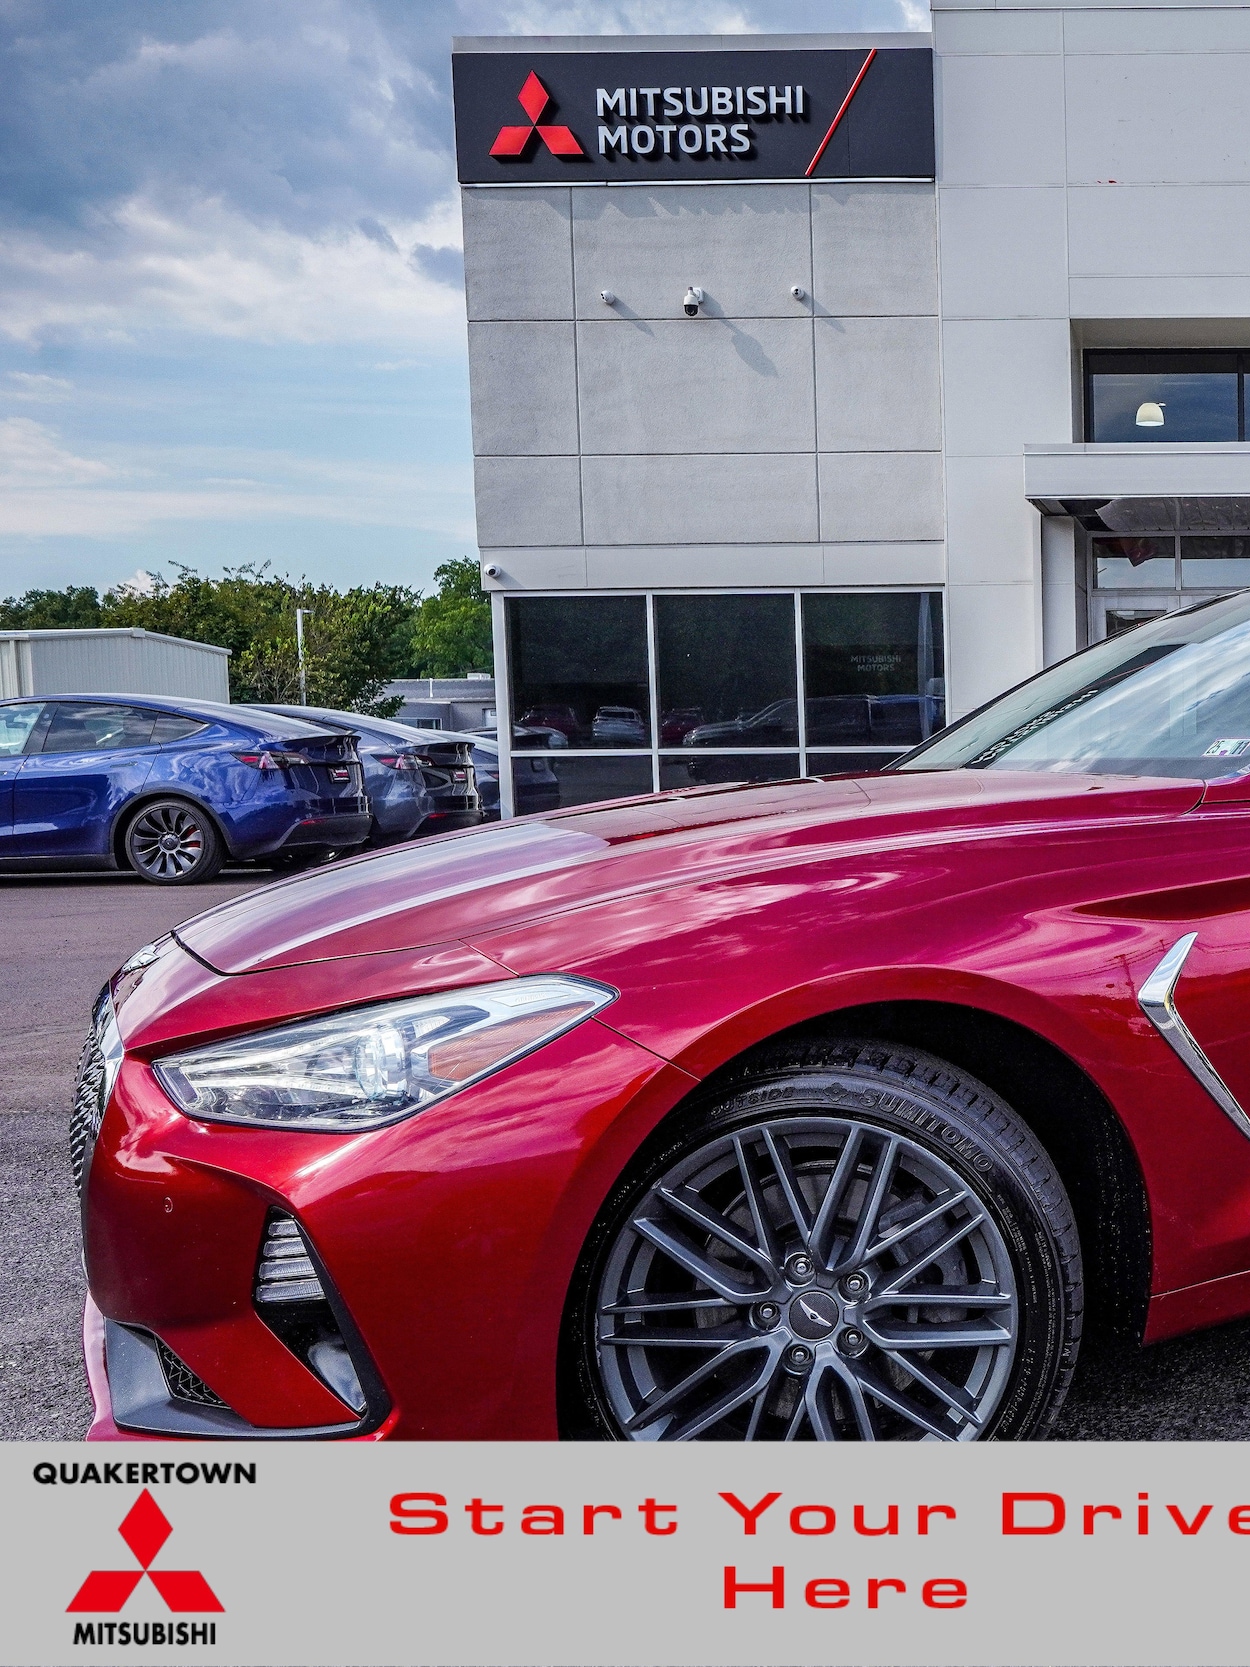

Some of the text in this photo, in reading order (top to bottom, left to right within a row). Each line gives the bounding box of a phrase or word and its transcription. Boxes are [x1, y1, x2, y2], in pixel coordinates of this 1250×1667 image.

[596, 86, 804, 117] MITSUBISHI
[598, 124, 750, 154] MOTORS
[850, 655, 902, 663] MITSUBISHI
[857, 663, 896, 672] MOTORS
[1206, 740, 1250, 755] 25 11
[859, 1088, 994, 1174] SUMITOMO
